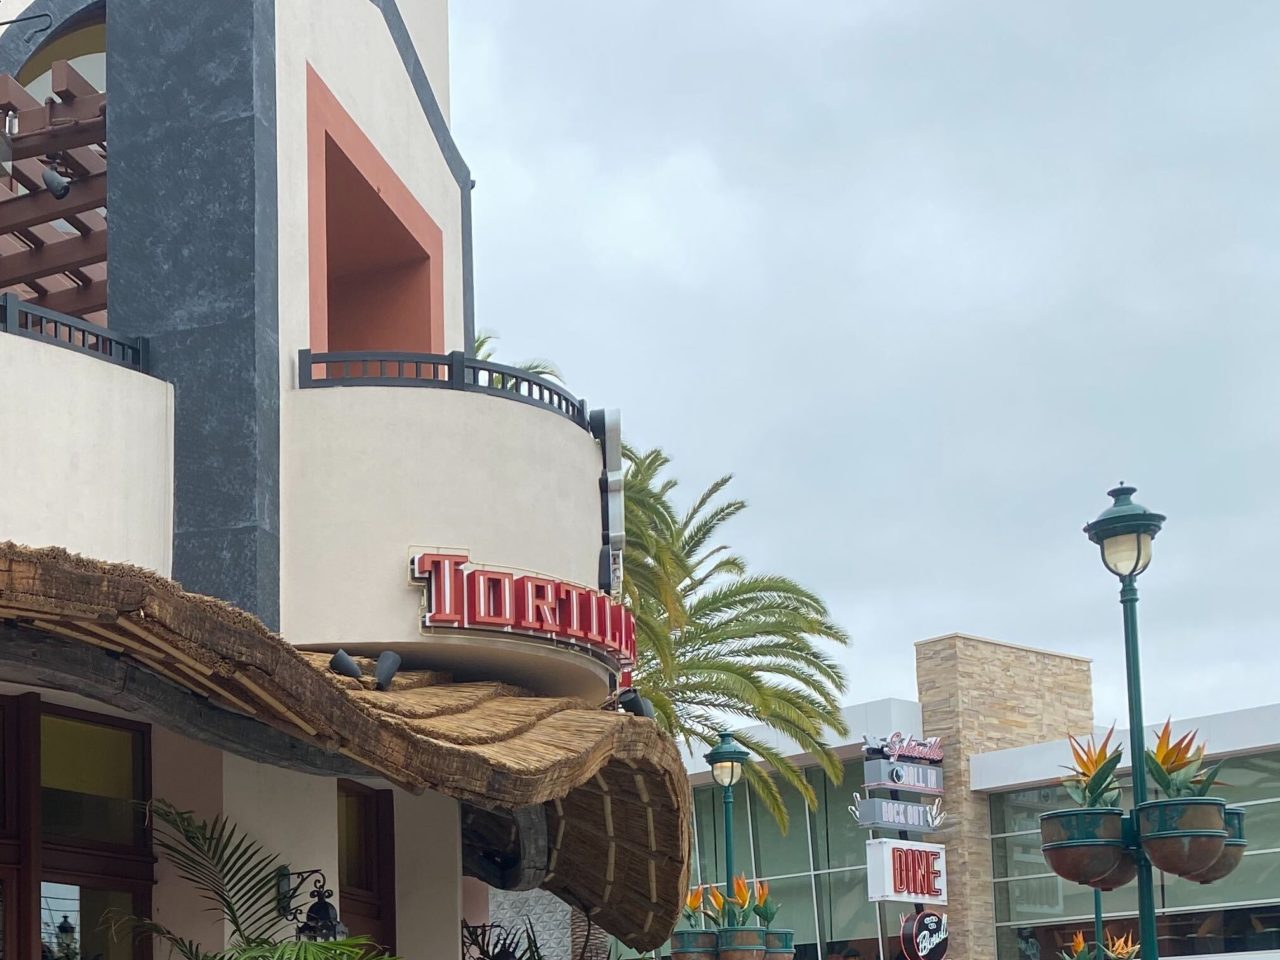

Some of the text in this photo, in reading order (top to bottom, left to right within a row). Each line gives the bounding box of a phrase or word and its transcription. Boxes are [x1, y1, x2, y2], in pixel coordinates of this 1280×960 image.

[882, 801, 925, 826] ROCK OUT
[892, 847, 942, 896] DINE
